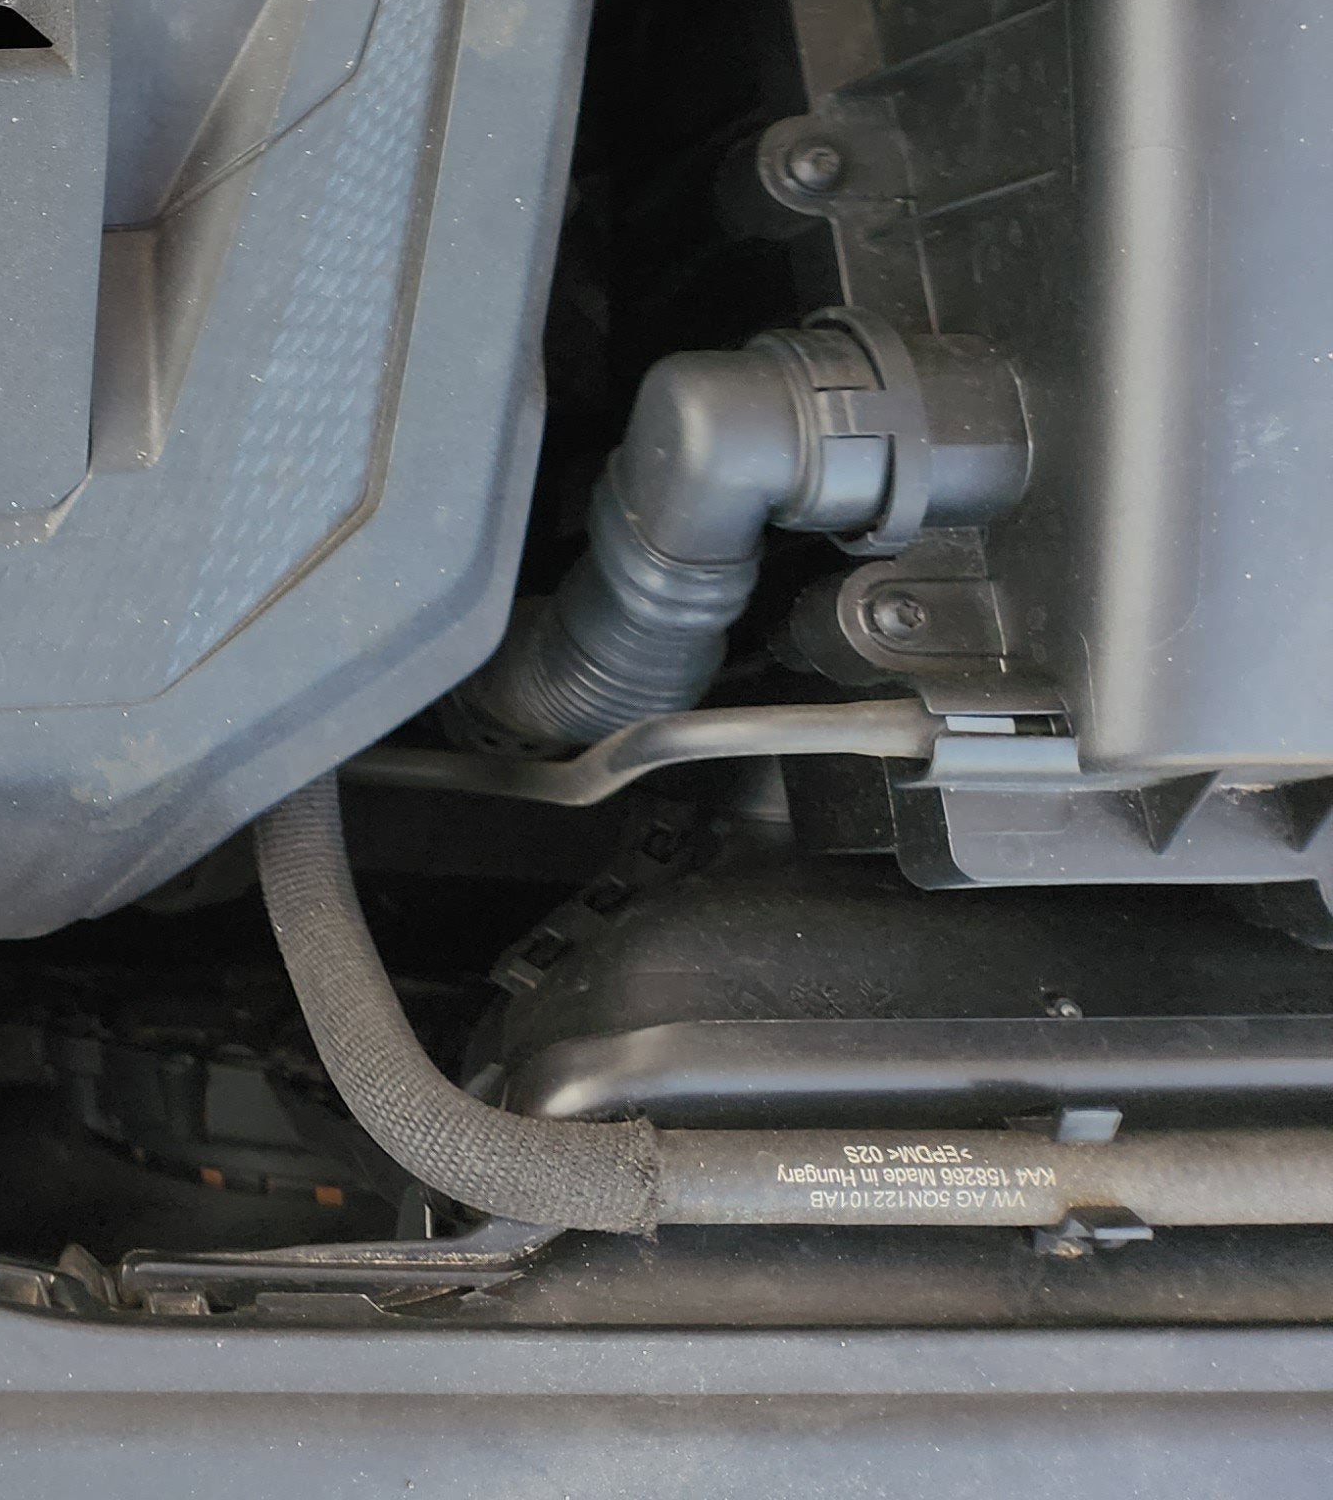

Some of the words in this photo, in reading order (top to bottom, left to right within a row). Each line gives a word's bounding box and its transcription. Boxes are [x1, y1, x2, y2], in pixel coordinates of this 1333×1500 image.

[842, 1145, 885, 1164] 02S
[885, 1144, 974, 1164] >EPDM<
[776, 1163, 857, 1188] Hungary
[859, 1167, 880, 1188] in
[882, 1166, 937, 1187] Made
[939, 1166, 1011, 1187] 158266
[1014, 1166, 1057, 1187] KA4
[809, 1189, 951, 1209] 5QN122101AB
[955, 1189, 987, 1209] AG
[990, 1189, 1026, 1209] VW
